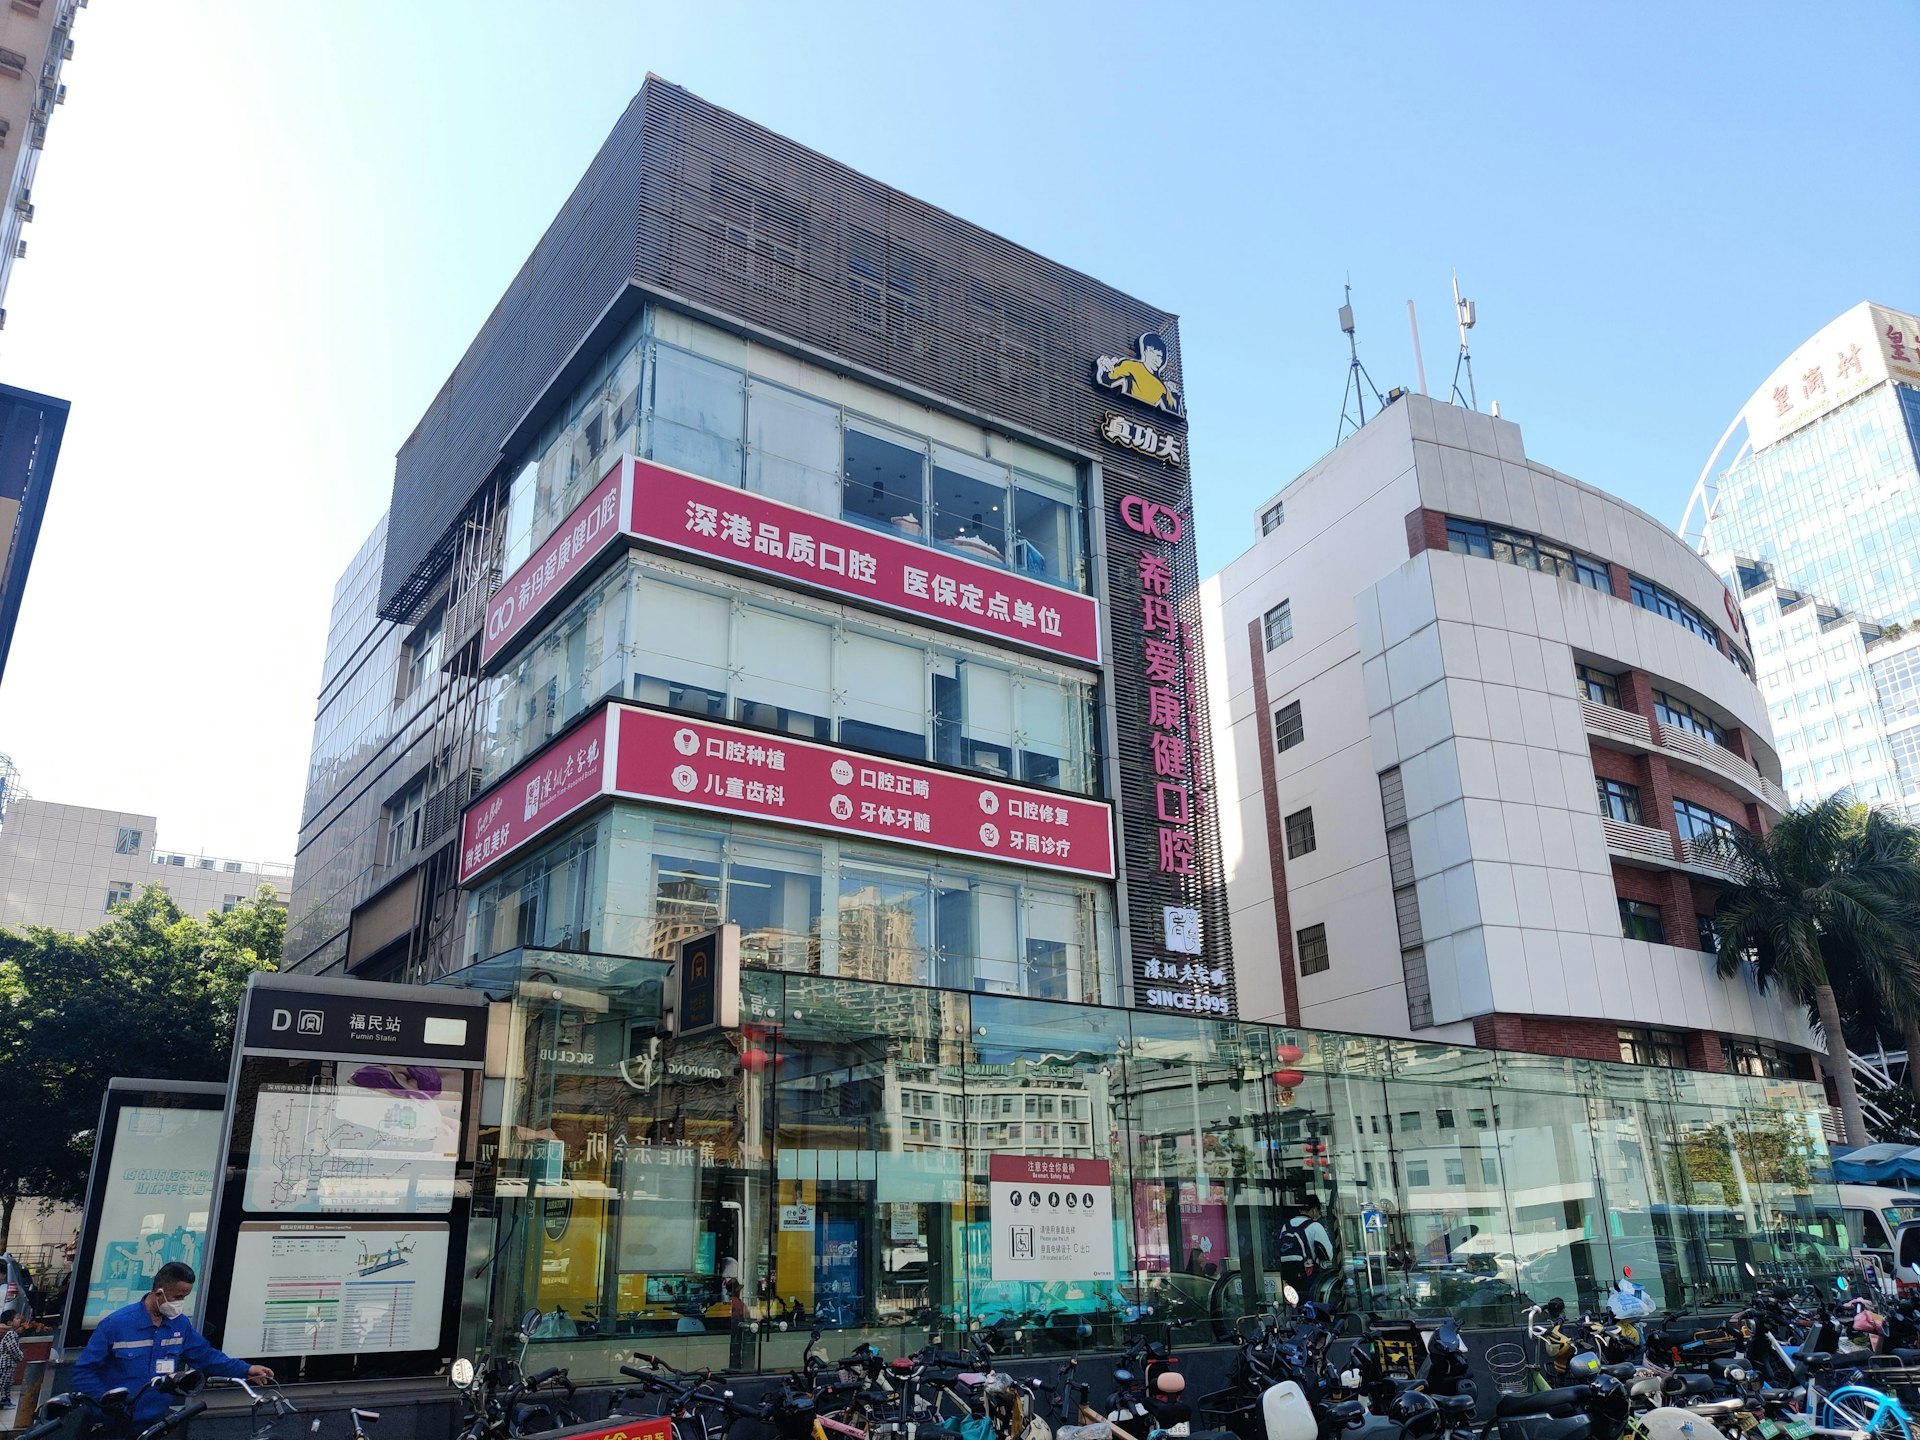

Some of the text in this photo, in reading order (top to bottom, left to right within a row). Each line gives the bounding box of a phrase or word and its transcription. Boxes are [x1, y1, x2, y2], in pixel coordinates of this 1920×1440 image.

[1104, 416, 1182, 464] 真功夫
[487, 487, 618, 612] 希玛爱康健口腔
[685, 500, 1062, 637] 深港品质口腔 医保定点单位
[1137, 549, 1197, 876] 希玛爱康健口腔
[705, 737, 786, 772] 口腔种植
[704, 772, 785, 807] 儿童齿科
[860, 768, 930, 800] 口腔正畸
[539, 793, 557, 810] Shenzhen
[1008, 799, 1069, 826] 口腔修复
[860, 801, 931, 833] 牙体牙髓
[464, 822, 510, 873] 微笑见美好
[1009, 830, 1071, 858] 牙周诊疗
[1146, 989, 1229, 1013] SINCE 1995
[271, 1009, 292, 1031] D
[349, 1013, 401, 1033] 福民站
[350, 1032, 374, 1041] Fumin
[123, 1168, 214, 1181] 疫情防控不松
[1027, 1161, 1076, 1174] 注意安全你最棒
[1040, 1225, 1076, 1235] 请使用垂直电梯
[1073, 1243, 1079, 1253] C
[1080, 1245, 1090, 1254] 出口
